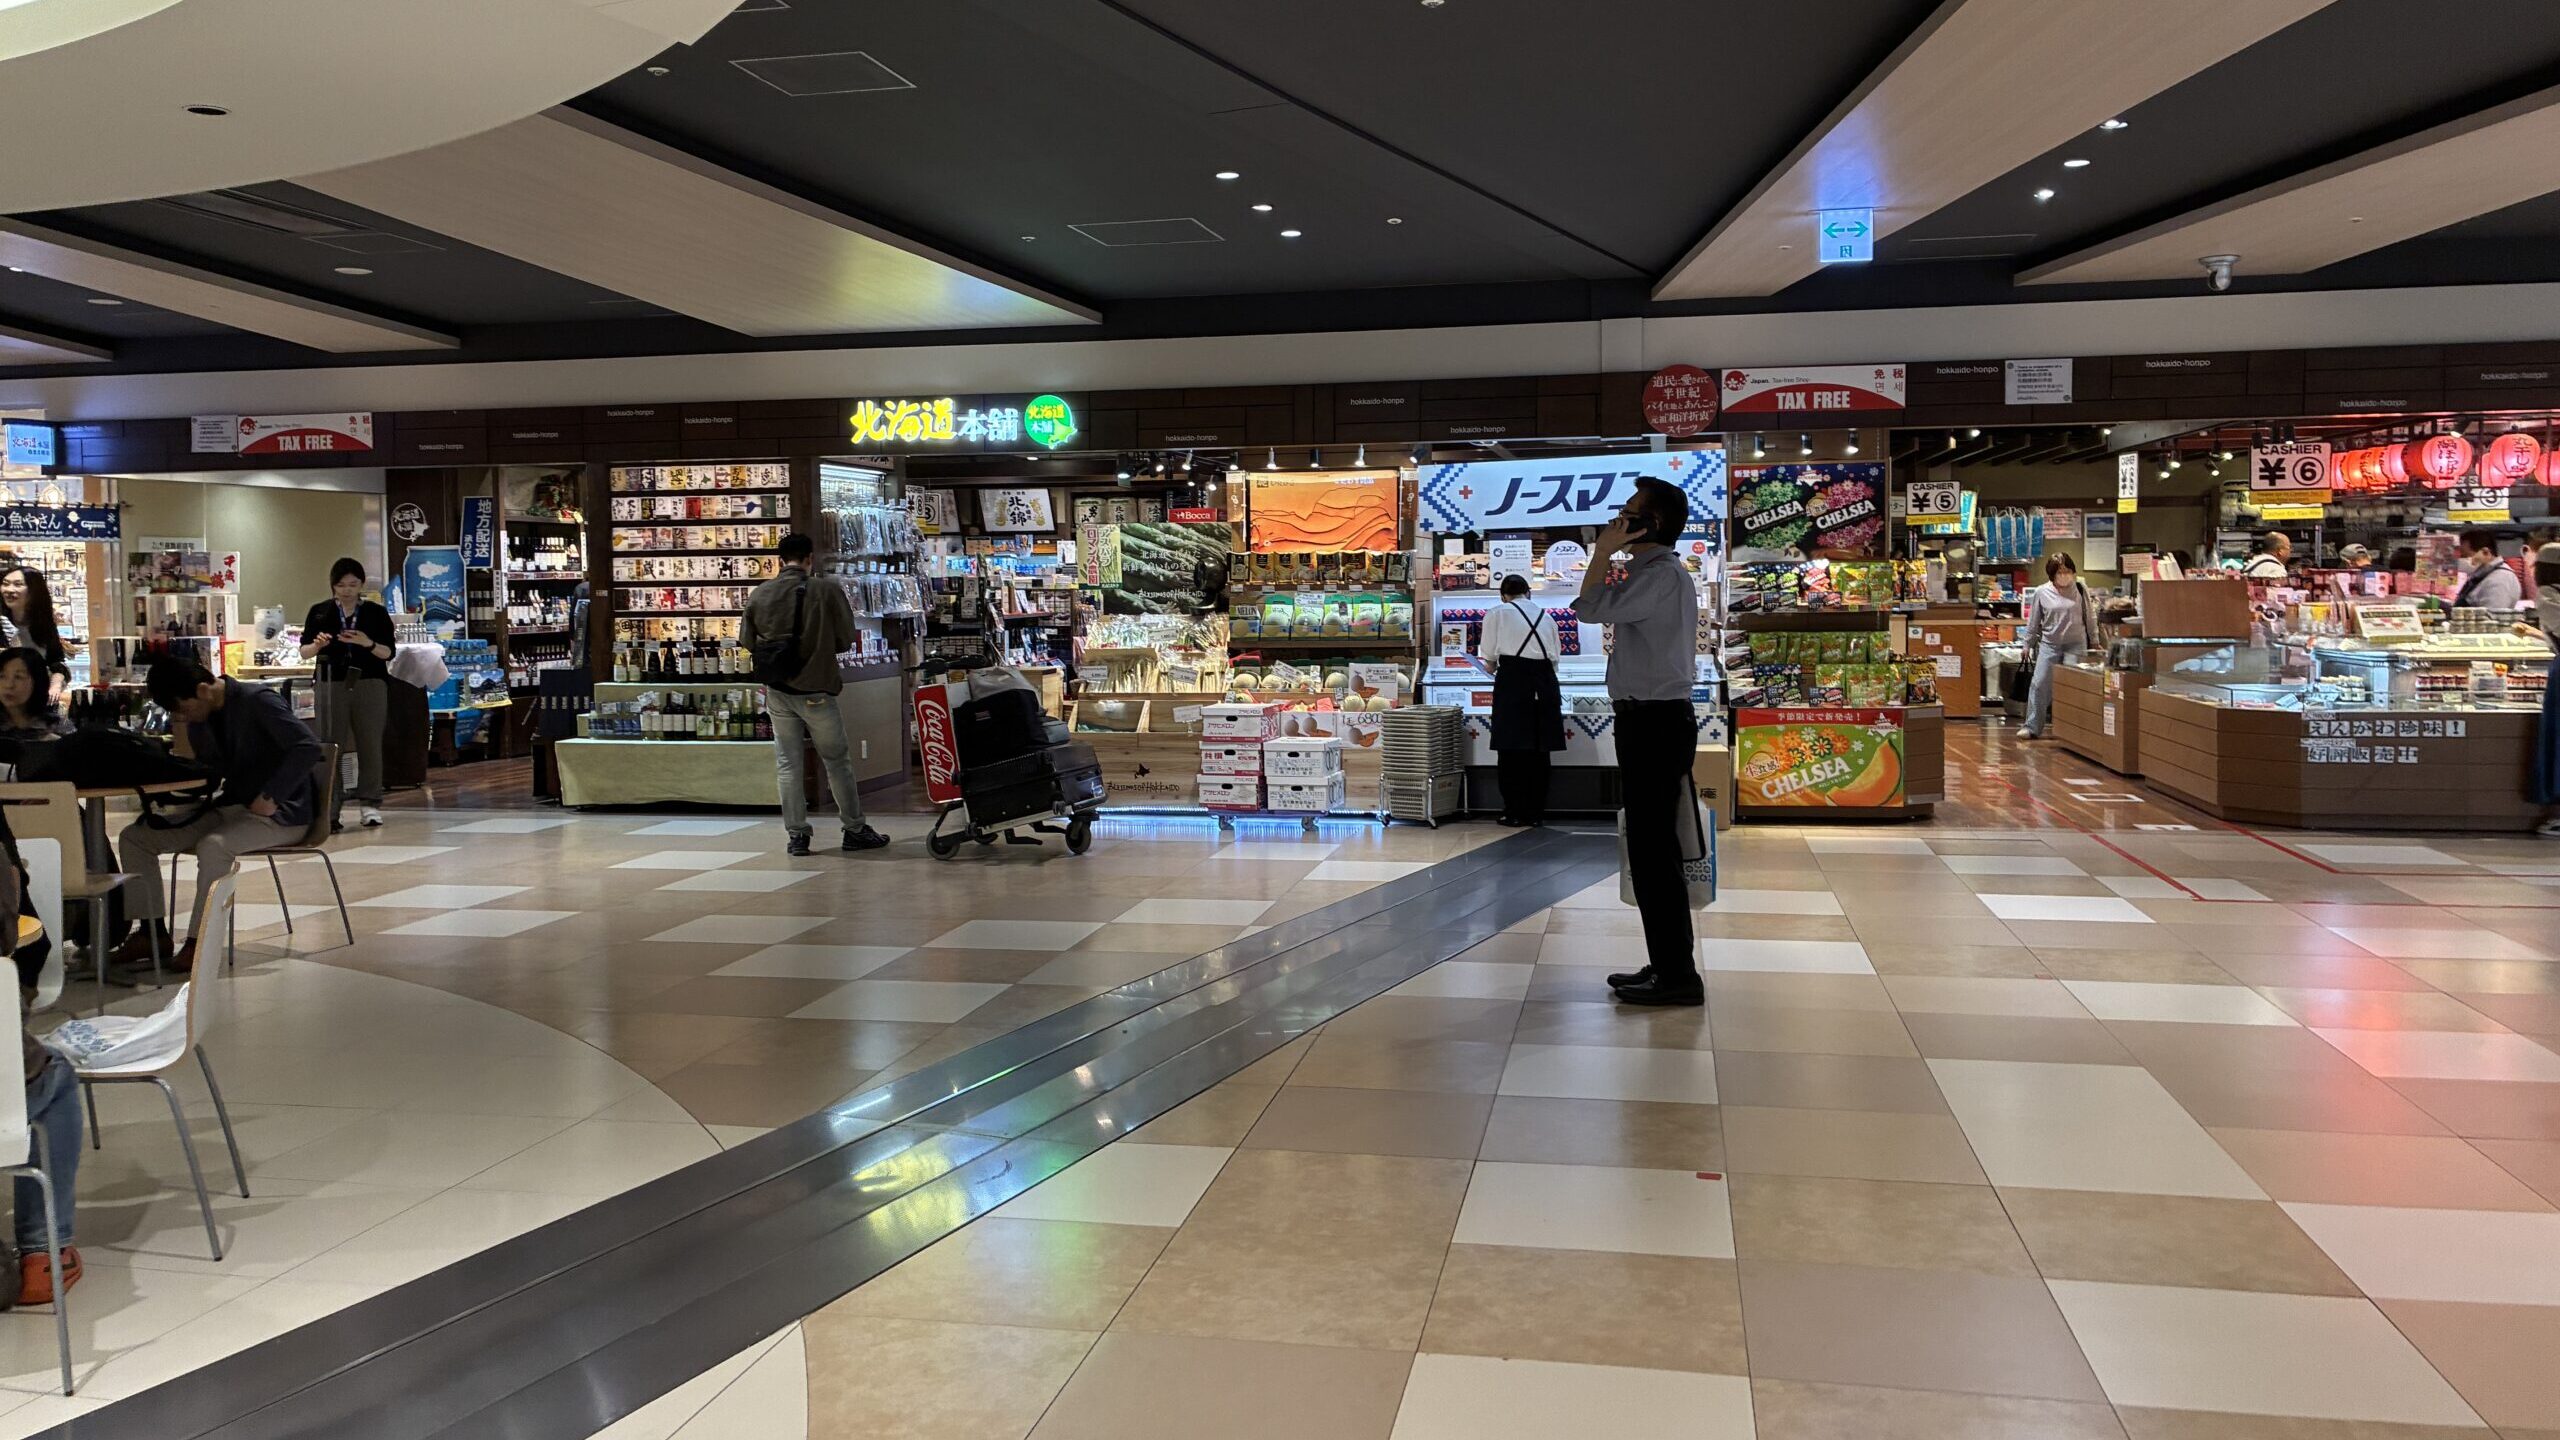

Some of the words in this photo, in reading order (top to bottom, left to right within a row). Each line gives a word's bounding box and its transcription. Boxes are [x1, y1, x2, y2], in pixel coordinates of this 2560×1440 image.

[1937, 366, 1999, 375] hokkaido-honpo
[1664, 386, 1701, 399] 半世紀
[1350, 398, 1405, 406] hokkaido-honpo
[1776, 393, 1806, 410] TAX
[1813, 391, 1850, 409] FREE
[1029, 405, 1065, 419] 北海道
[1032, 420, 1054, 434] 本舗
[1667, 425, 1698, 434] スイーツ
[277, 436, 301, 450] TAX
[305, 435, 334, 449] FREE
[2260, 445, 2322, 455] CASHIER
[1912, 482, 1954, 491] CASHIER
[1744, 500, 1804, 530] CHELSEA
[1816, 499, 1876, 530] CHELSEA
[475, 500, 492, 557] 地方配送
[464, 534, 474, 565] 承ります
[1099, 528, 1113, 566] アスパラ
[1761, 756, 1853, 801] CHELSEA
